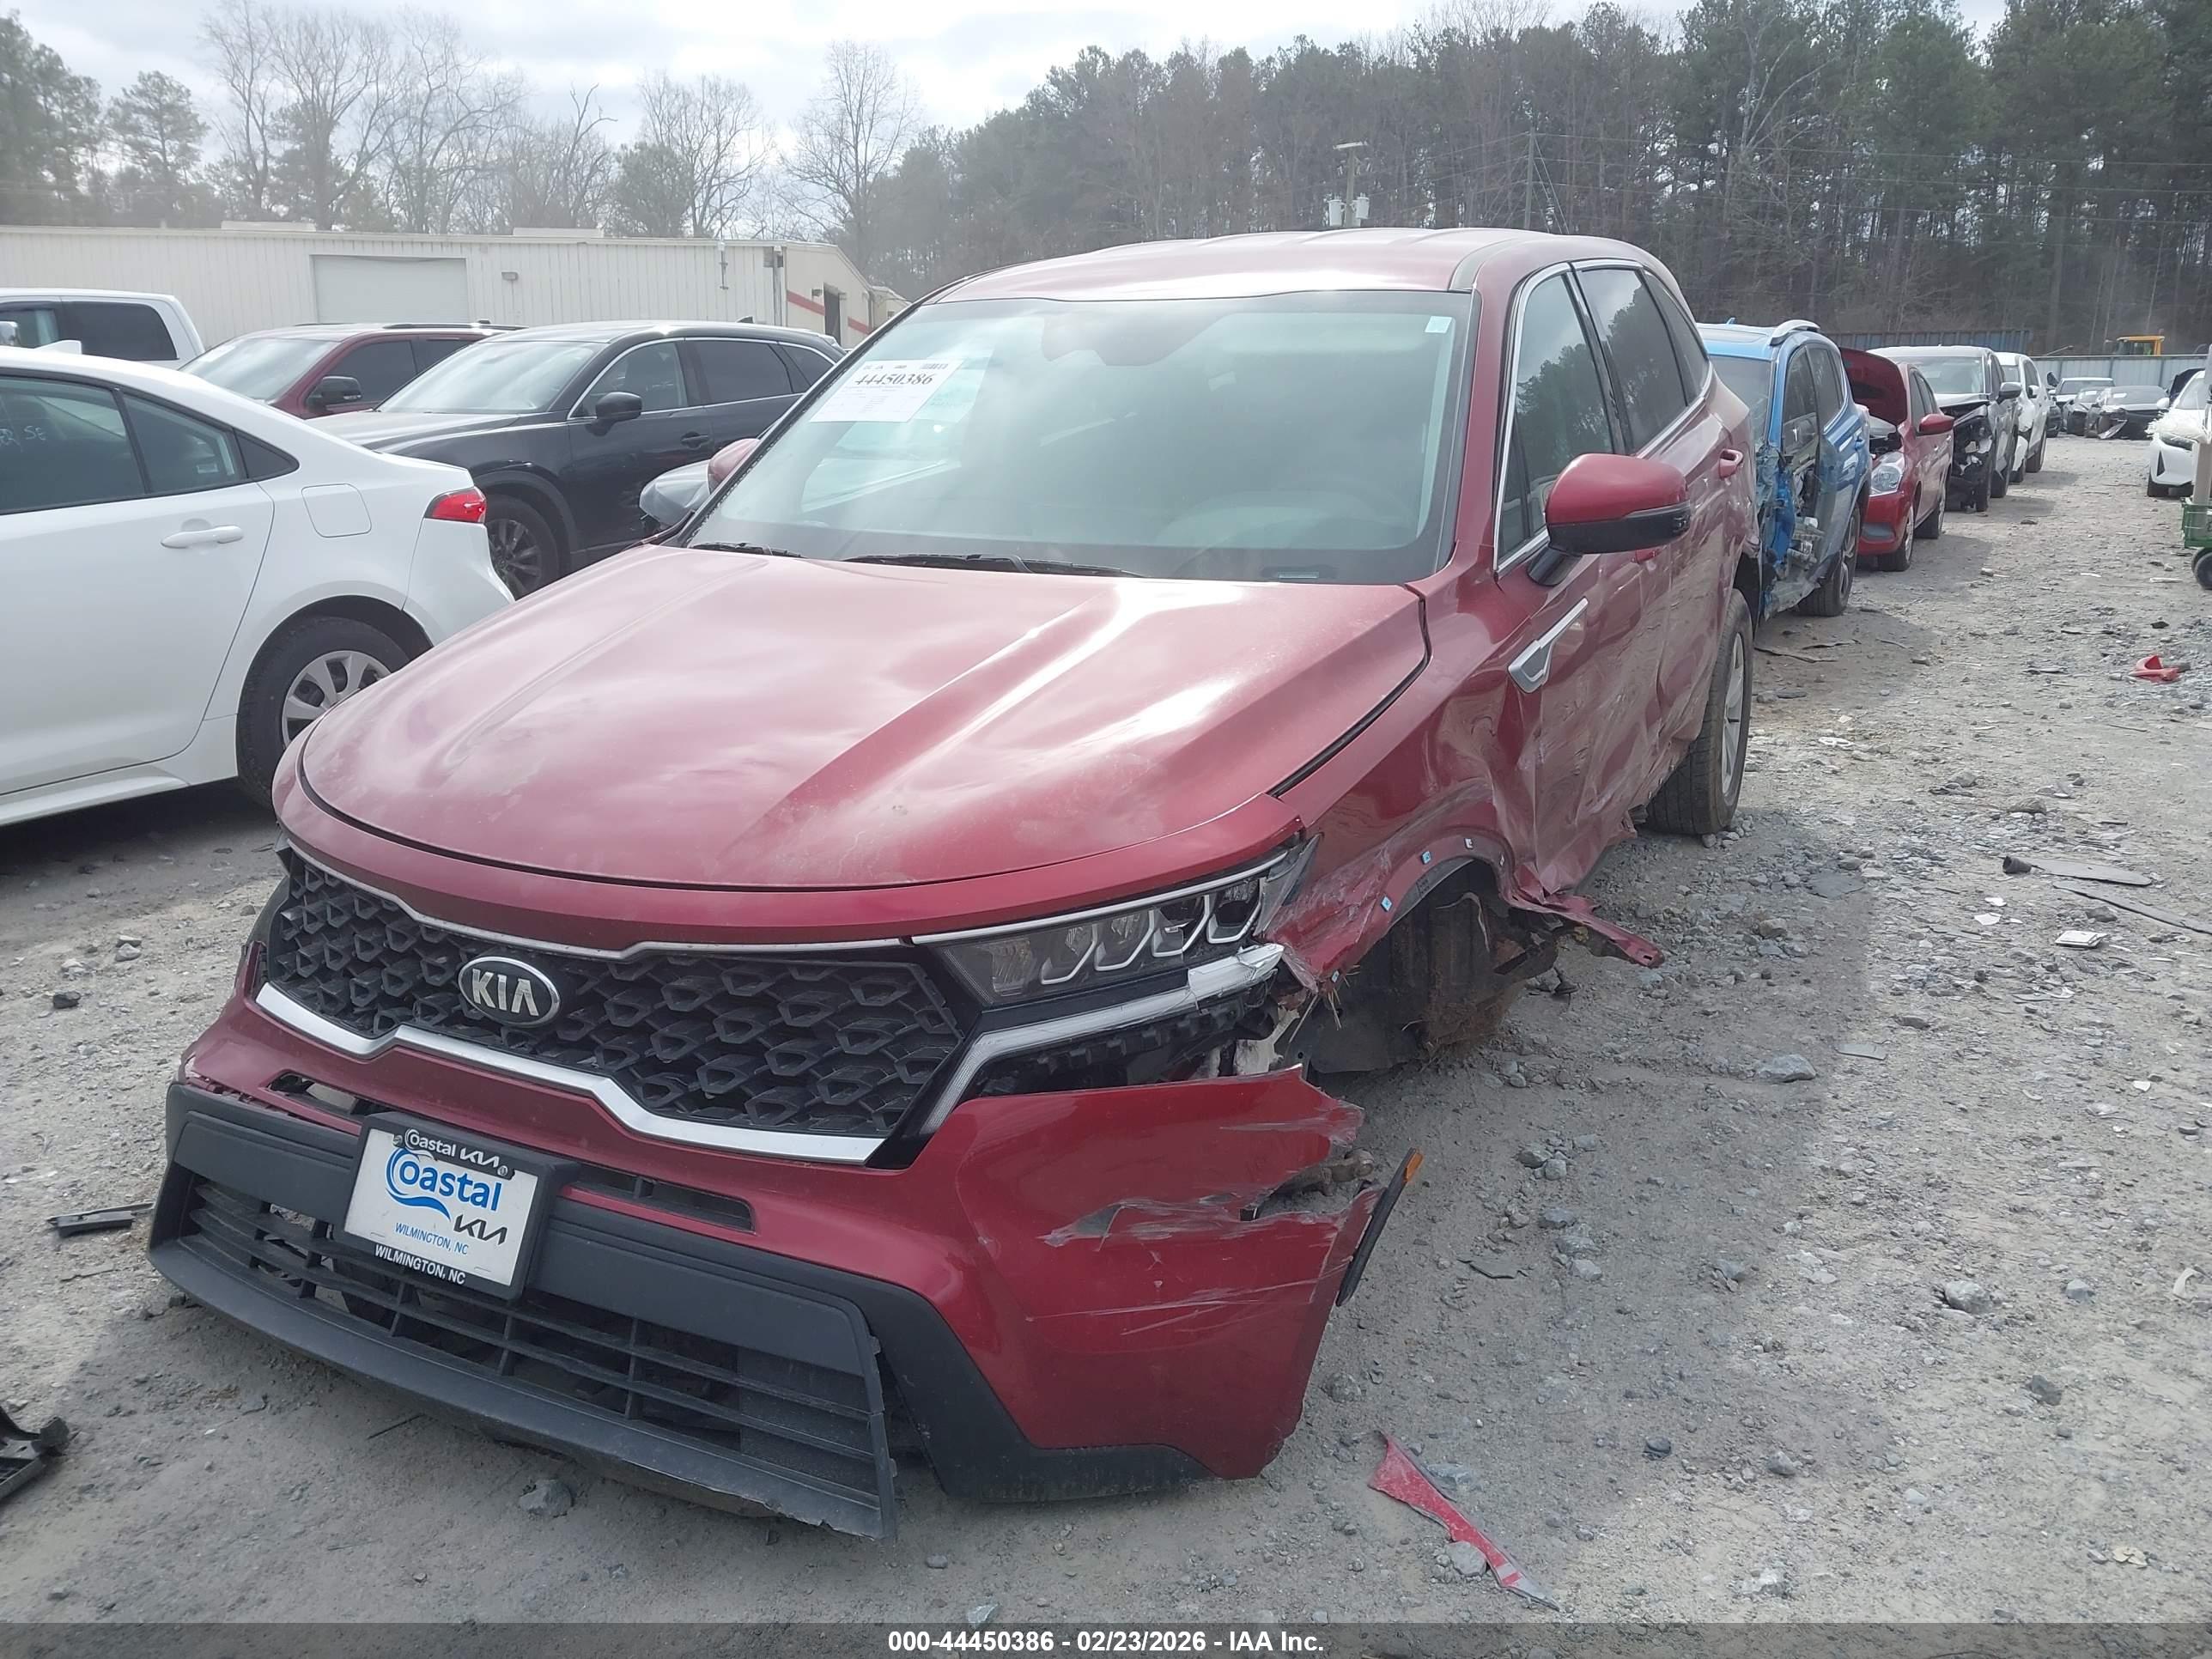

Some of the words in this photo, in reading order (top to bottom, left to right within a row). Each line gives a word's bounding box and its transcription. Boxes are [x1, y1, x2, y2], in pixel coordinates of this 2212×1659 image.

[855, 372, 936, 385] 44450386
[471, 967, 539, 1017] KIA
[404, 1128, 456, 1158] Coastal
[386, 1147, 502, 1212] Coastal
[395, 1222, 453, 1251] WILMINGTON,
[454, 1242, 470, 1255] NC
[374, 1243, 447, 1279] WILMINGTON,
[447, 1269, 466, 1285] NC
